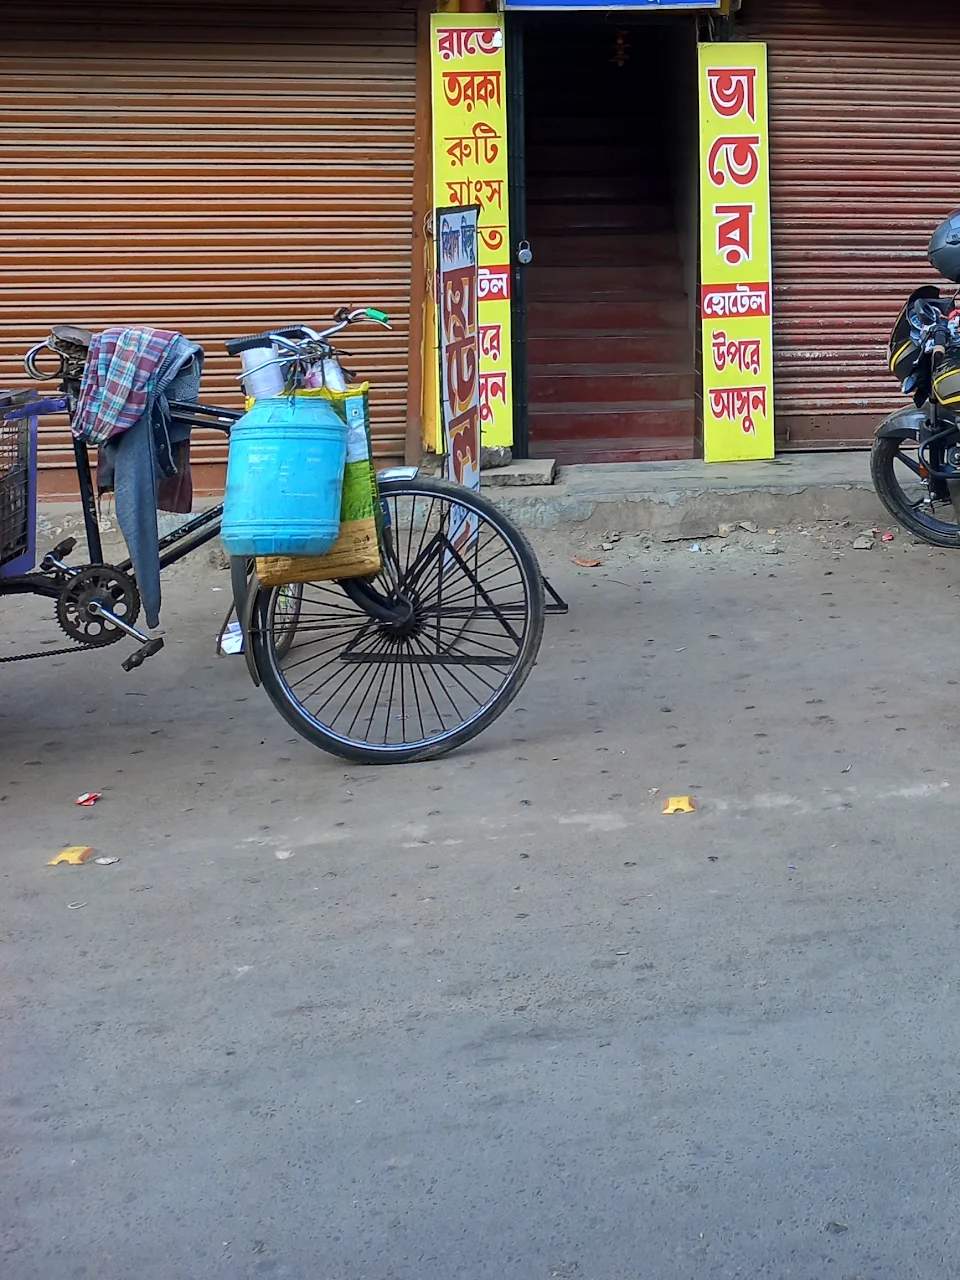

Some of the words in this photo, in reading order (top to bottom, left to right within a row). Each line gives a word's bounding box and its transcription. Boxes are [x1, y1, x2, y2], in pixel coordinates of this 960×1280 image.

[437, 28, 503, 60] রাতে
[442, 71, 501, 112] তরকা
[444, 122, 502, 167] রুটি
[446, 176, 504, 210] মাংস
[704, 283, 766, 316] হোটেল
[712, 329, 761, 376] উপরে
[709, 386, 766, 437] আসুন
